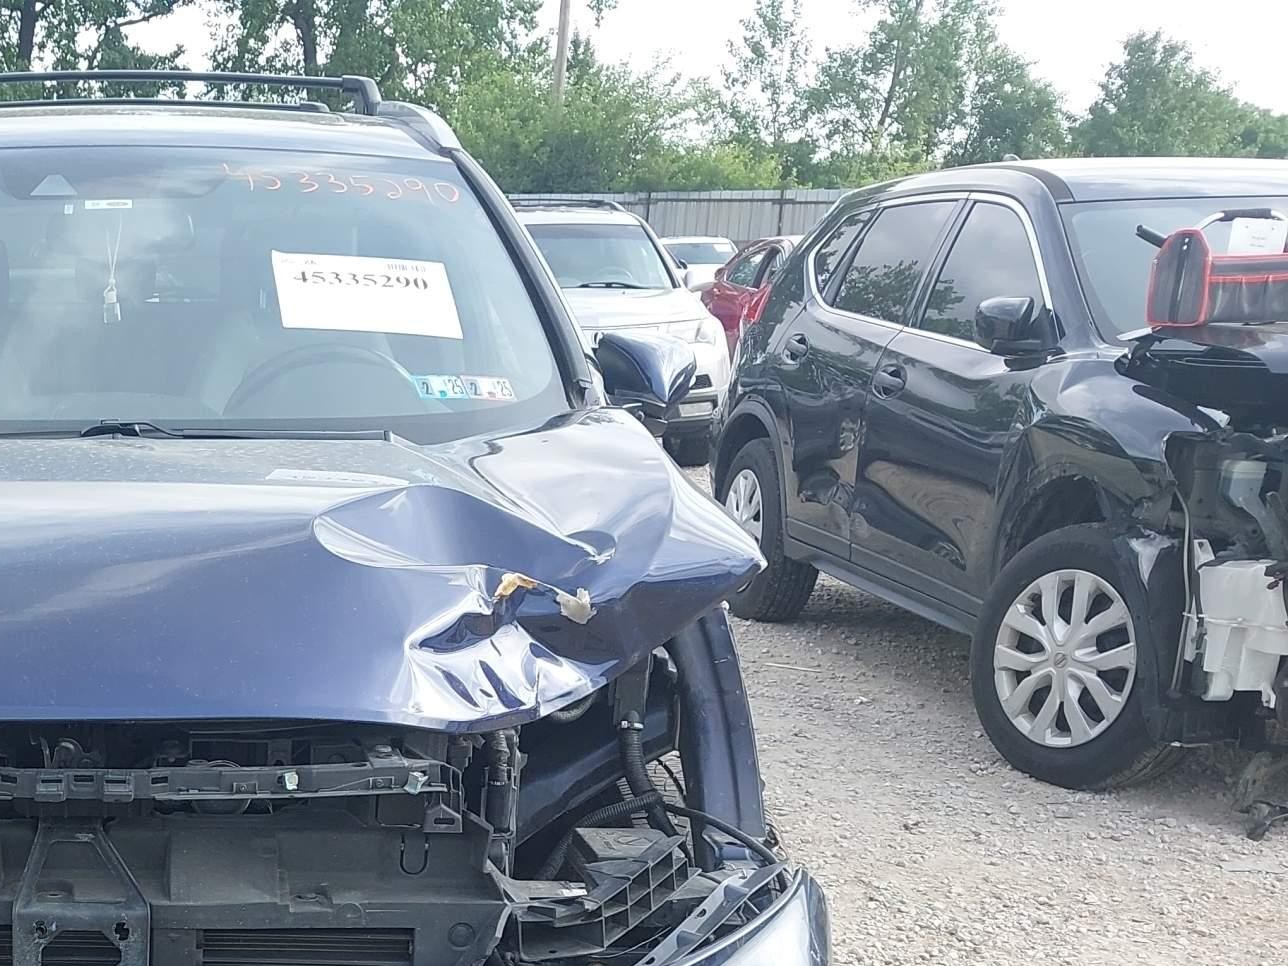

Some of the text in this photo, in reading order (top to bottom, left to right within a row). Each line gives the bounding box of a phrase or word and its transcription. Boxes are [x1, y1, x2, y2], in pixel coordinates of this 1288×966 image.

[293, 269, 429, 291] 45335290
[421, 381, 433, 395] 2
[470, 382, 482, 396] 2
